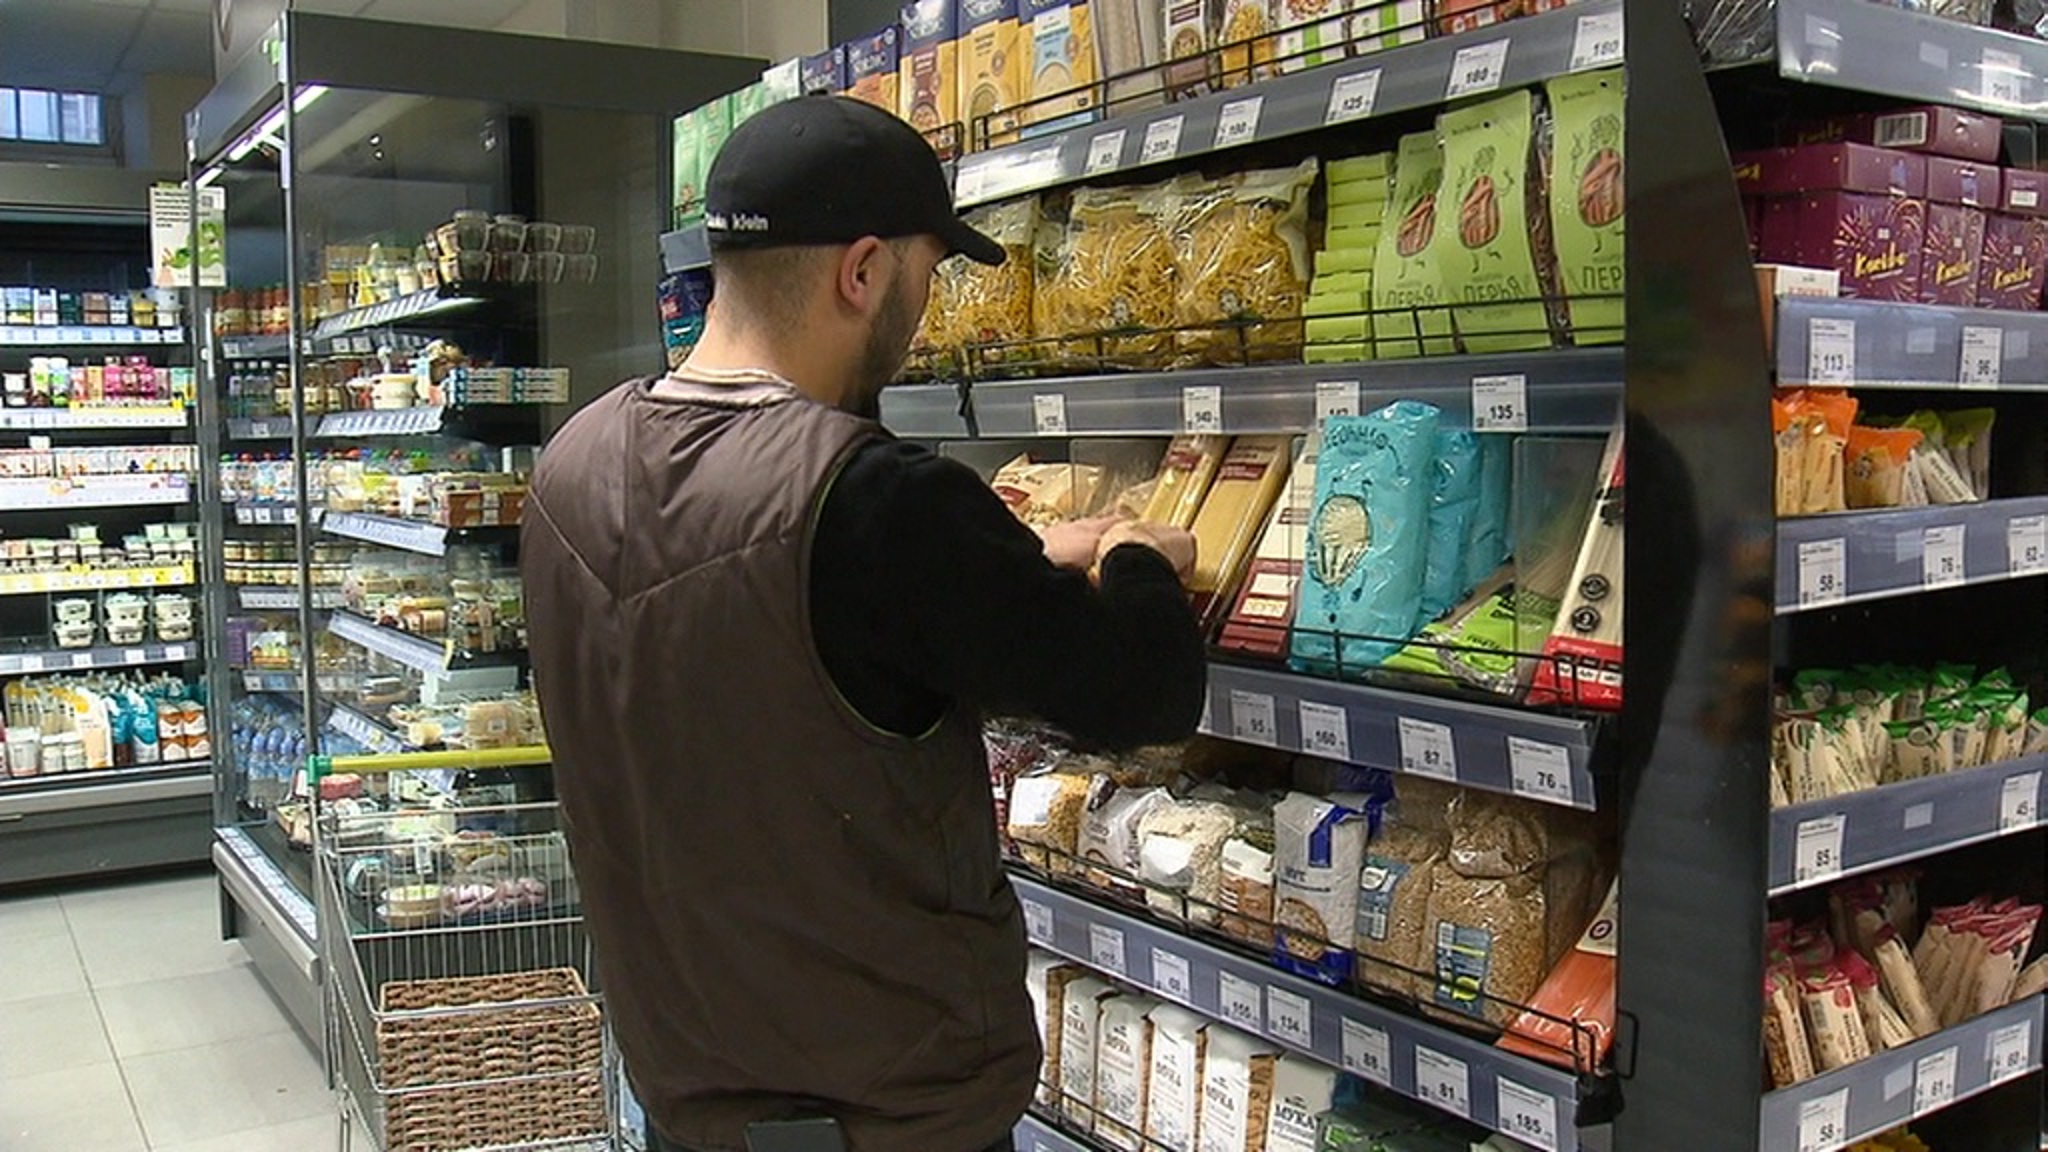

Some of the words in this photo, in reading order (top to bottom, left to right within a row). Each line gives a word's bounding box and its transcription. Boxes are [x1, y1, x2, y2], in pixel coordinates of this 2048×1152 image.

[1489, 404, 1513, 421] 135
[1424, 749, 1440, 765] 87
[1537, 771, 1557, 789] 76
[1439, 1083, 1456, 1101] 81
[1275, 1104, 1317, 1130] МУКА
[1516, 1113, 1543, 1135] 185
